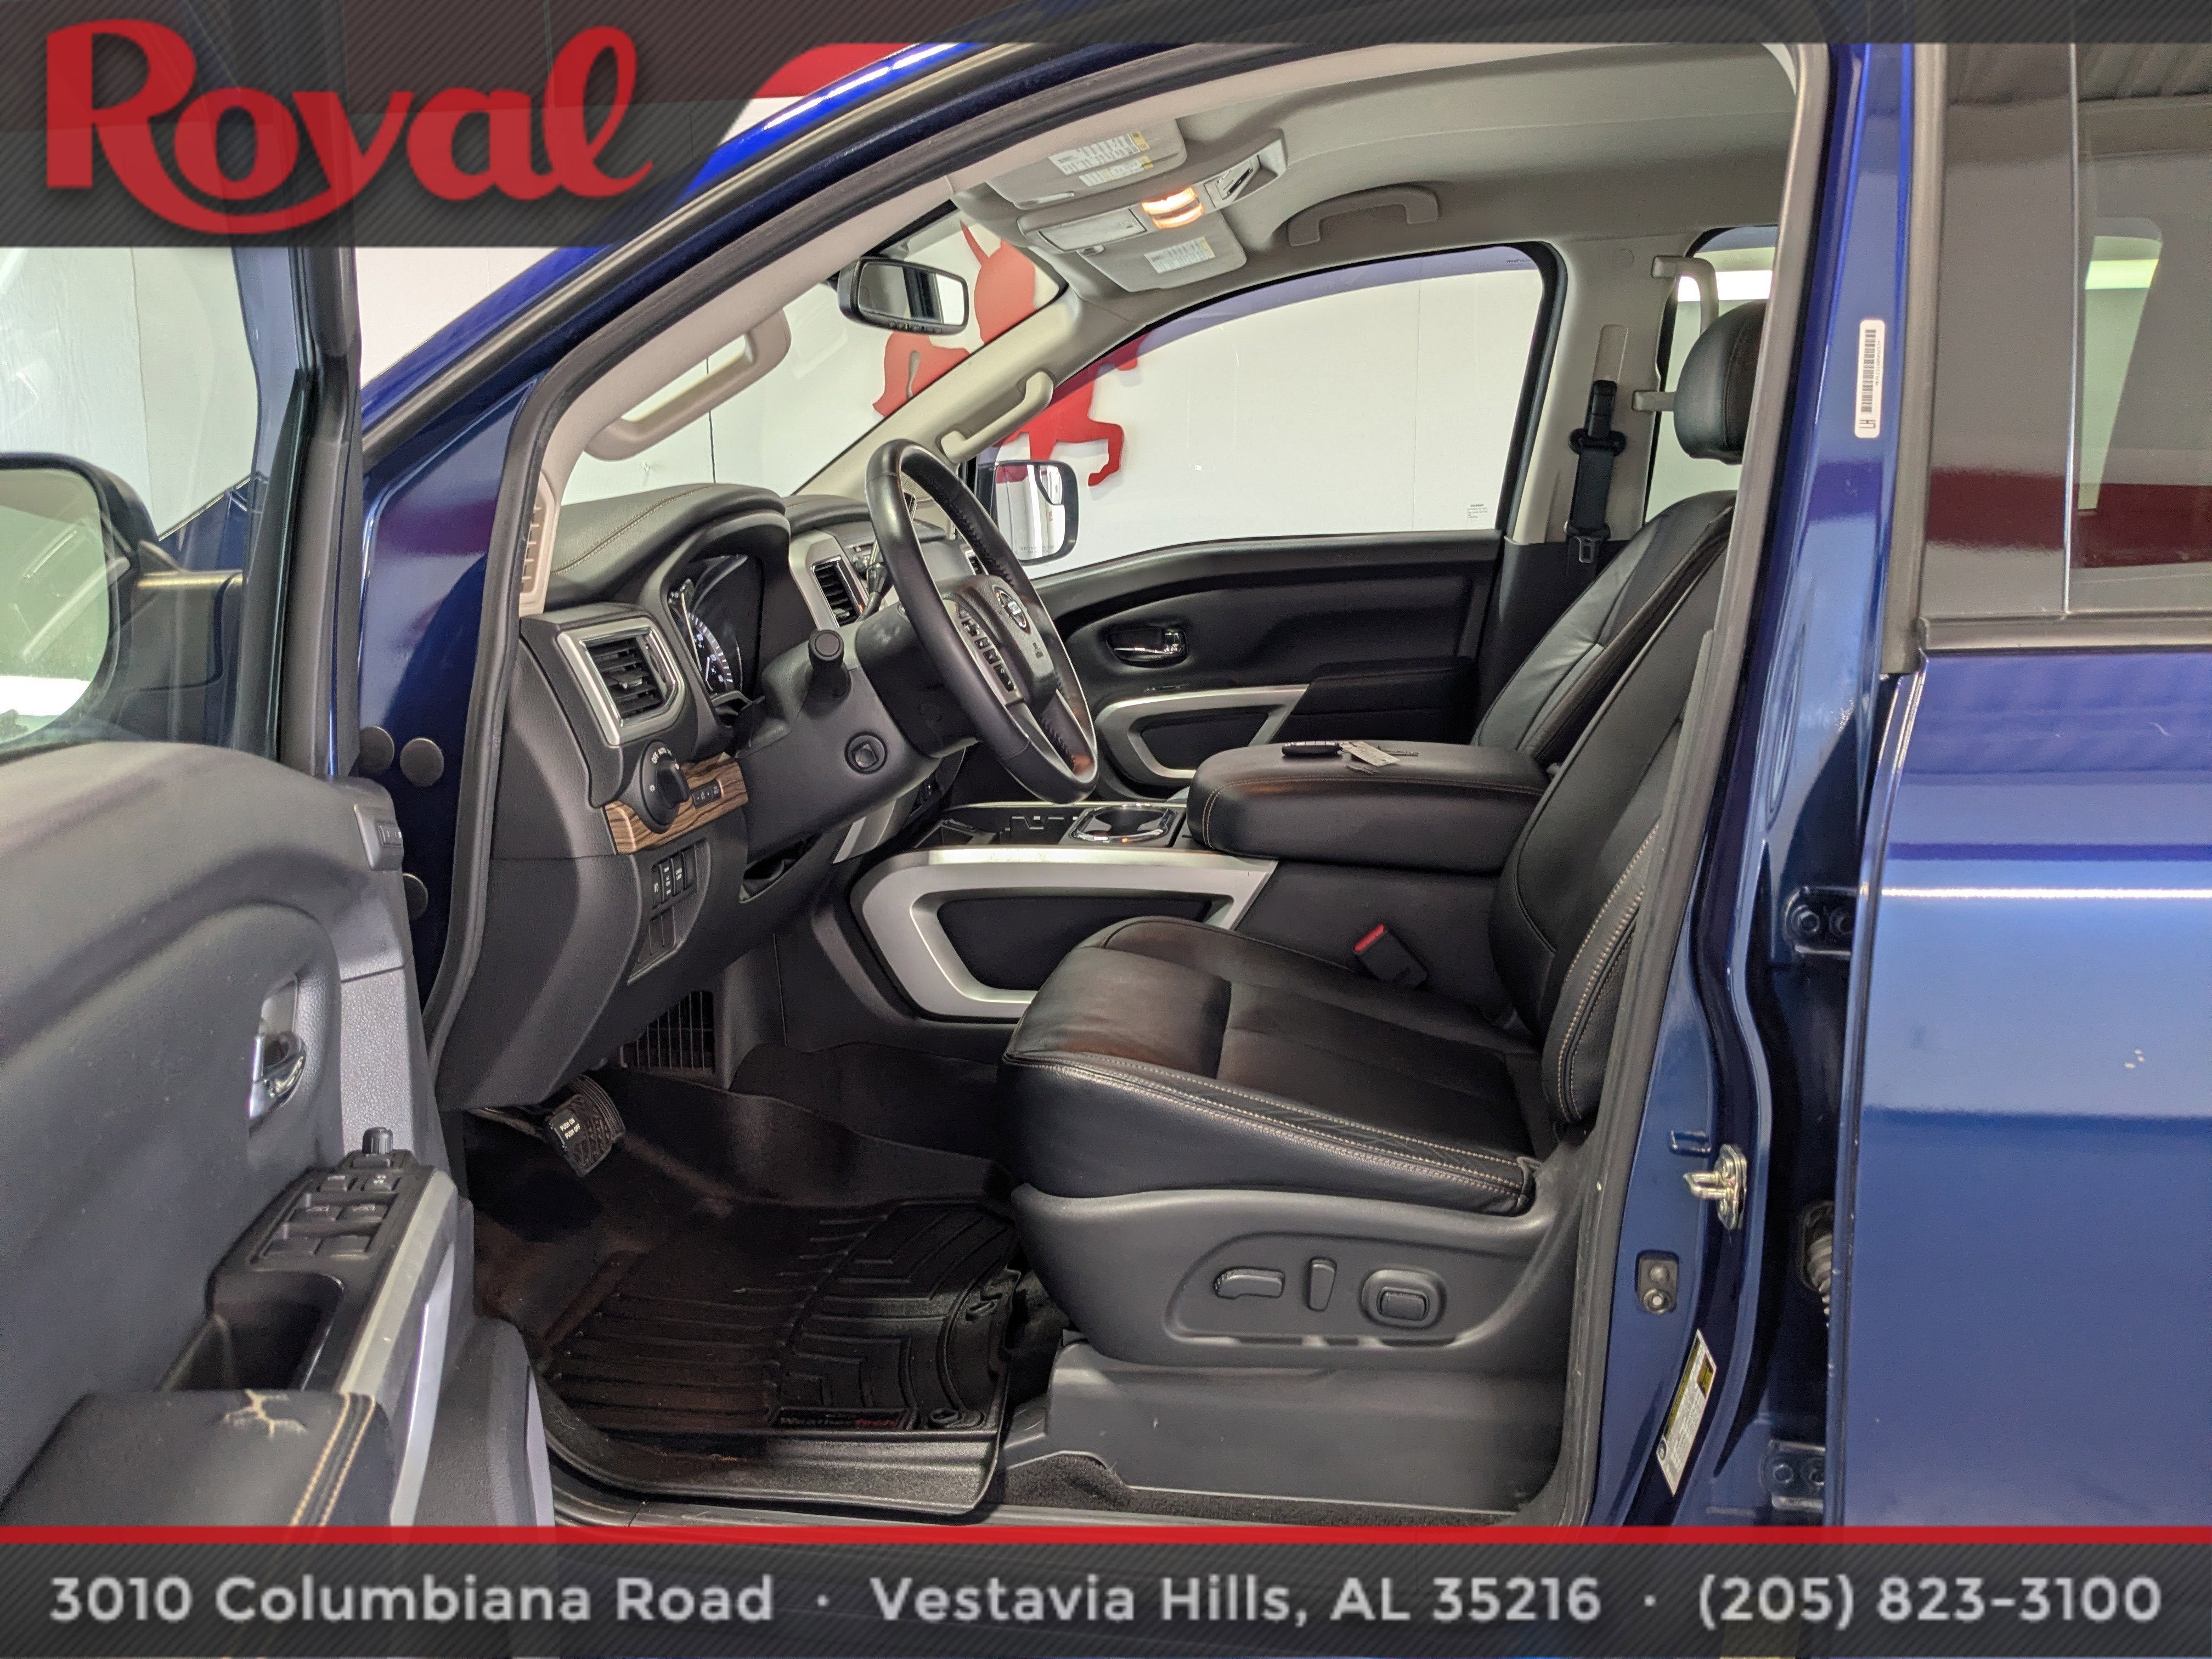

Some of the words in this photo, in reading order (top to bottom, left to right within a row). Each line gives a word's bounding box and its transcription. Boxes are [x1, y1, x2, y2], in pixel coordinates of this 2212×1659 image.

[560, 1121, 571, 1132] PUSH
[568, 1117, 575, 1125] ON
[565, 1128, 575, 1139] PUSH
